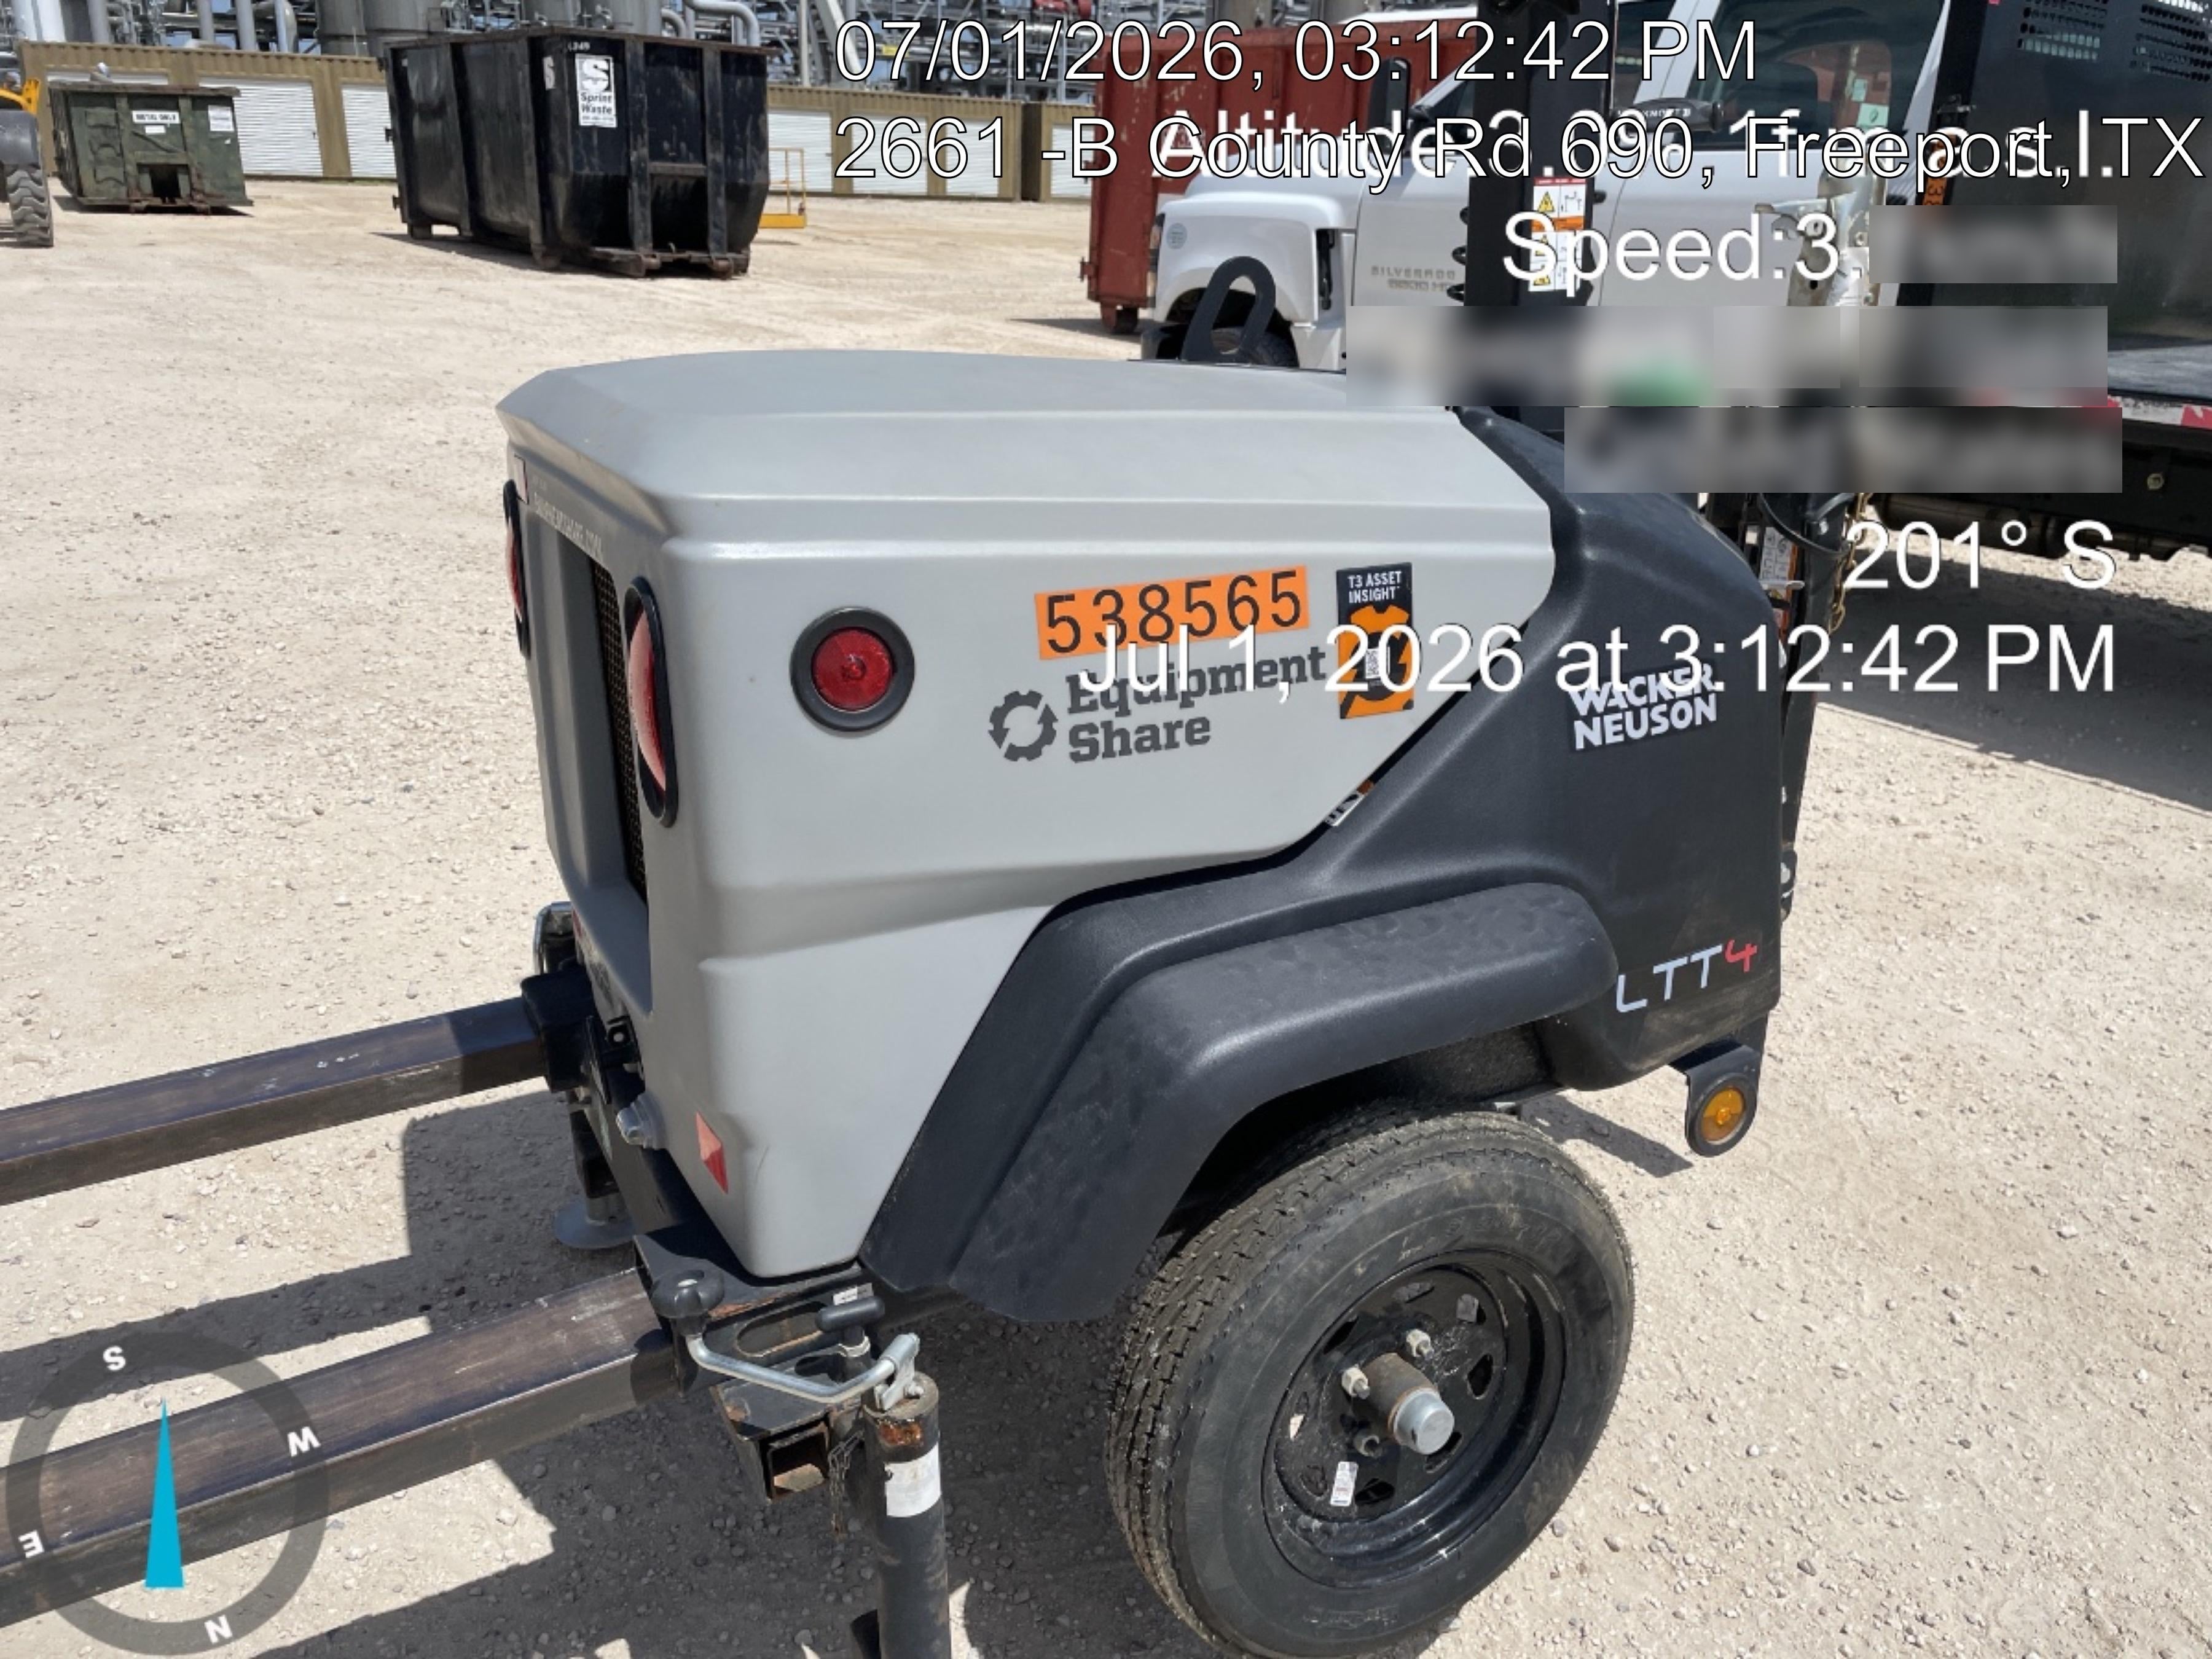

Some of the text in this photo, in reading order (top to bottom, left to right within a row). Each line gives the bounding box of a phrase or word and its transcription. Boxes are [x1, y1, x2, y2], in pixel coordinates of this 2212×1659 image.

[1347, 571, 1402, 589] T3 ASSET
[1348, 586, 1400, 603] INSIGHT
[1047, 570, 1301, 653] 538565
[1066, 646, 1327, 718] Equipment
[1568, 664, 1717, 716] WACKER
[1068, 716, 1212, 764] Share
[1573, 692, 1717, 751] NEUSON
[1615, 939, 1758, 1014] LTT4
